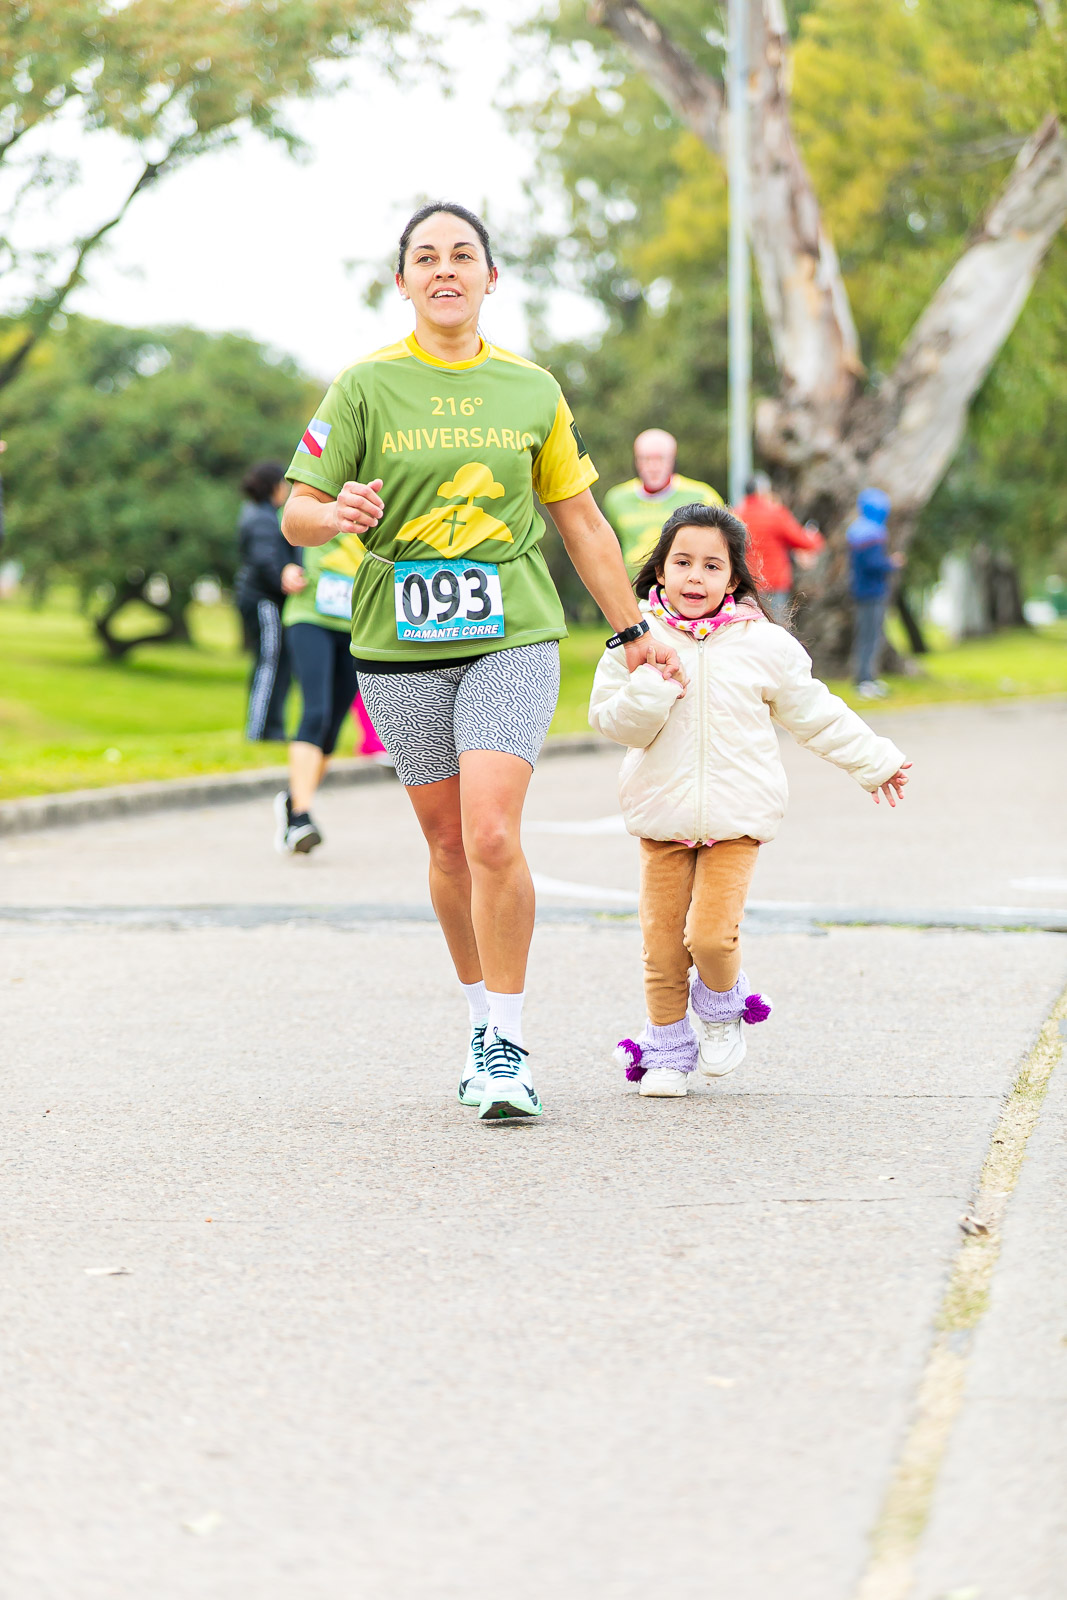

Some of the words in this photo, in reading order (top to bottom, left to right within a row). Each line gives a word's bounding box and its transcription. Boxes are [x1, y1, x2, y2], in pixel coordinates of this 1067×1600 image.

[381, 427, 535, 454] ANIVERSARIO
[402, 567, 492, 626] 093
[403, 627, 460, 639] DIAMANTE
[462, 624, 499, 636] CORRE
